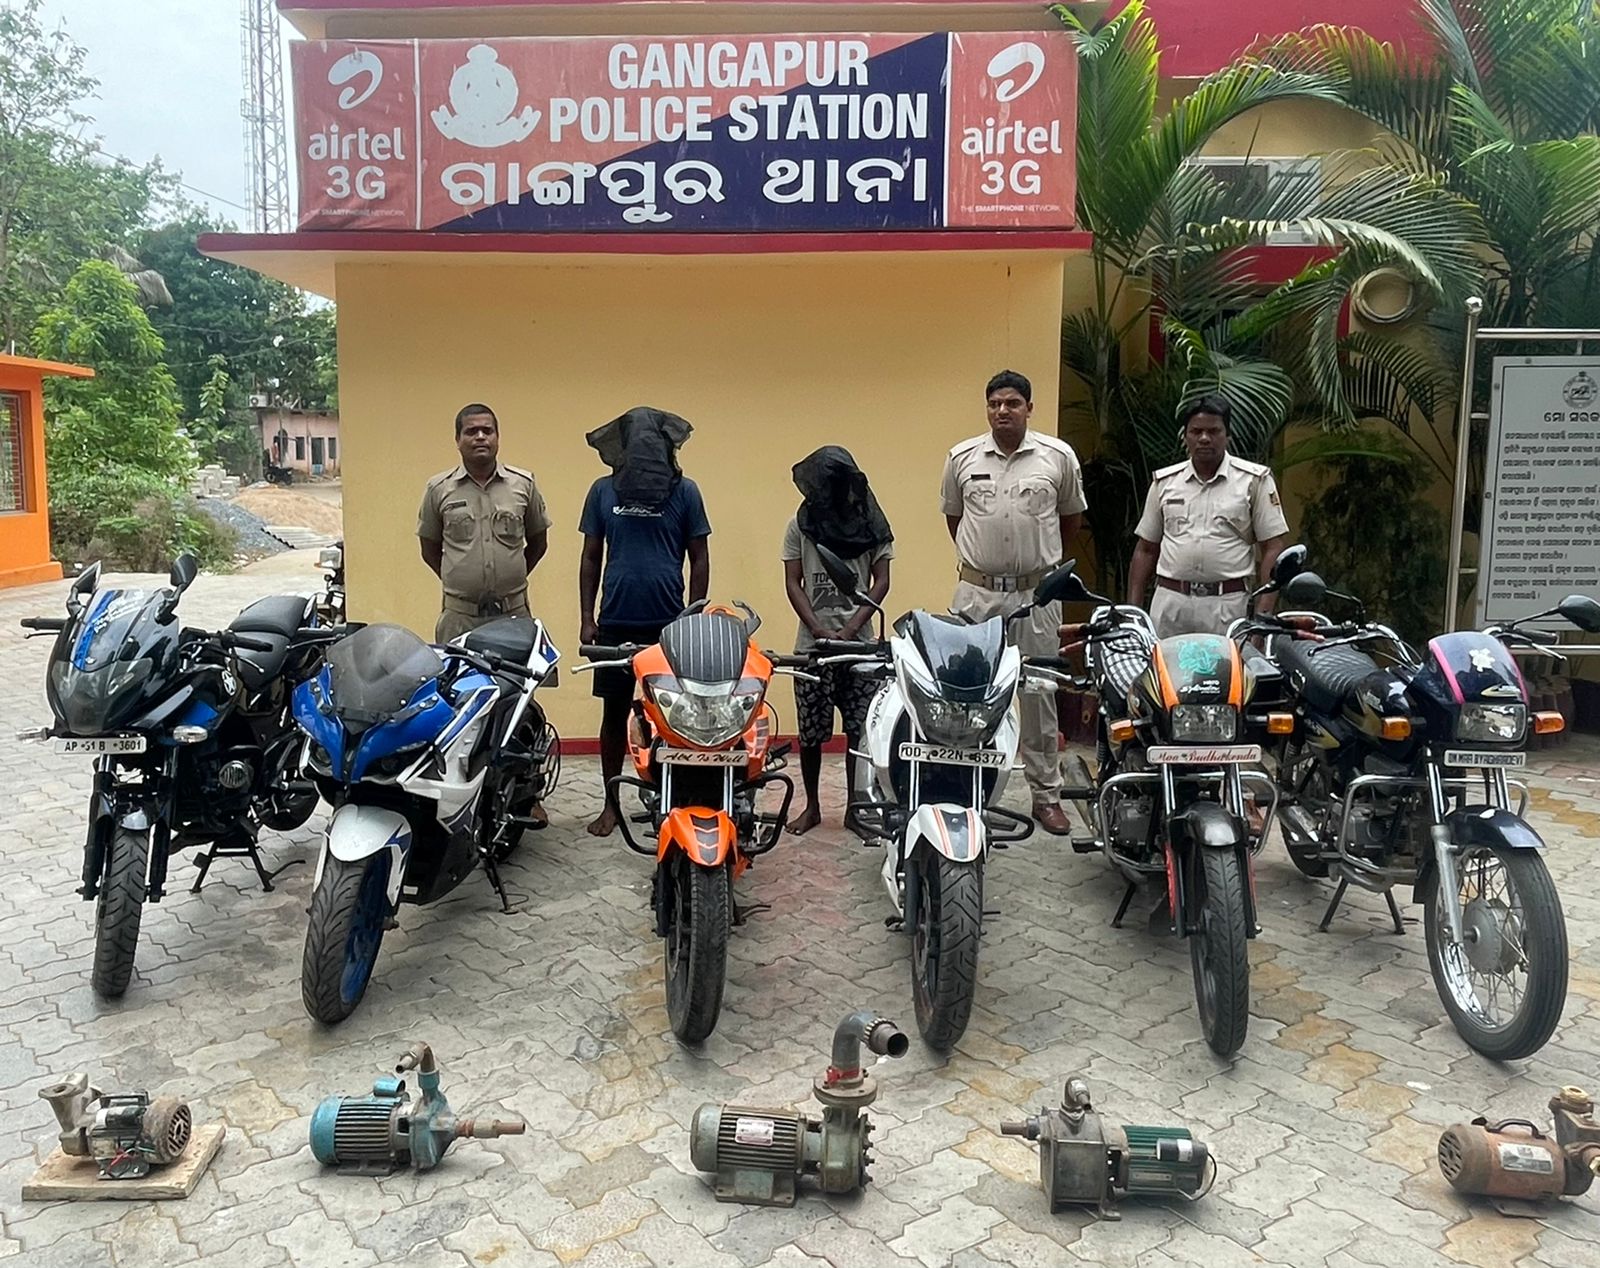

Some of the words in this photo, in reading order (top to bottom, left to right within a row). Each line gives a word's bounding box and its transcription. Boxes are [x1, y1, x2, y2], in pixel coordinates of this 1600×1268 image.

[607, 40, 869, 90] GANGAPUR
[549, 95, 713, 143] POLICE
[728, 92, 929, 142] STATION
[960, 117, 1063, 155] airtel
[307, 123, 406, 161] airtel
[326, 165, 386, 200] 3G
[762, 157, 928, 204] ଥାନା
[979, 159, 1042, 196] 3G
[64, 741, 78, 752] AP
[119, 739, 141, 751] 3601
